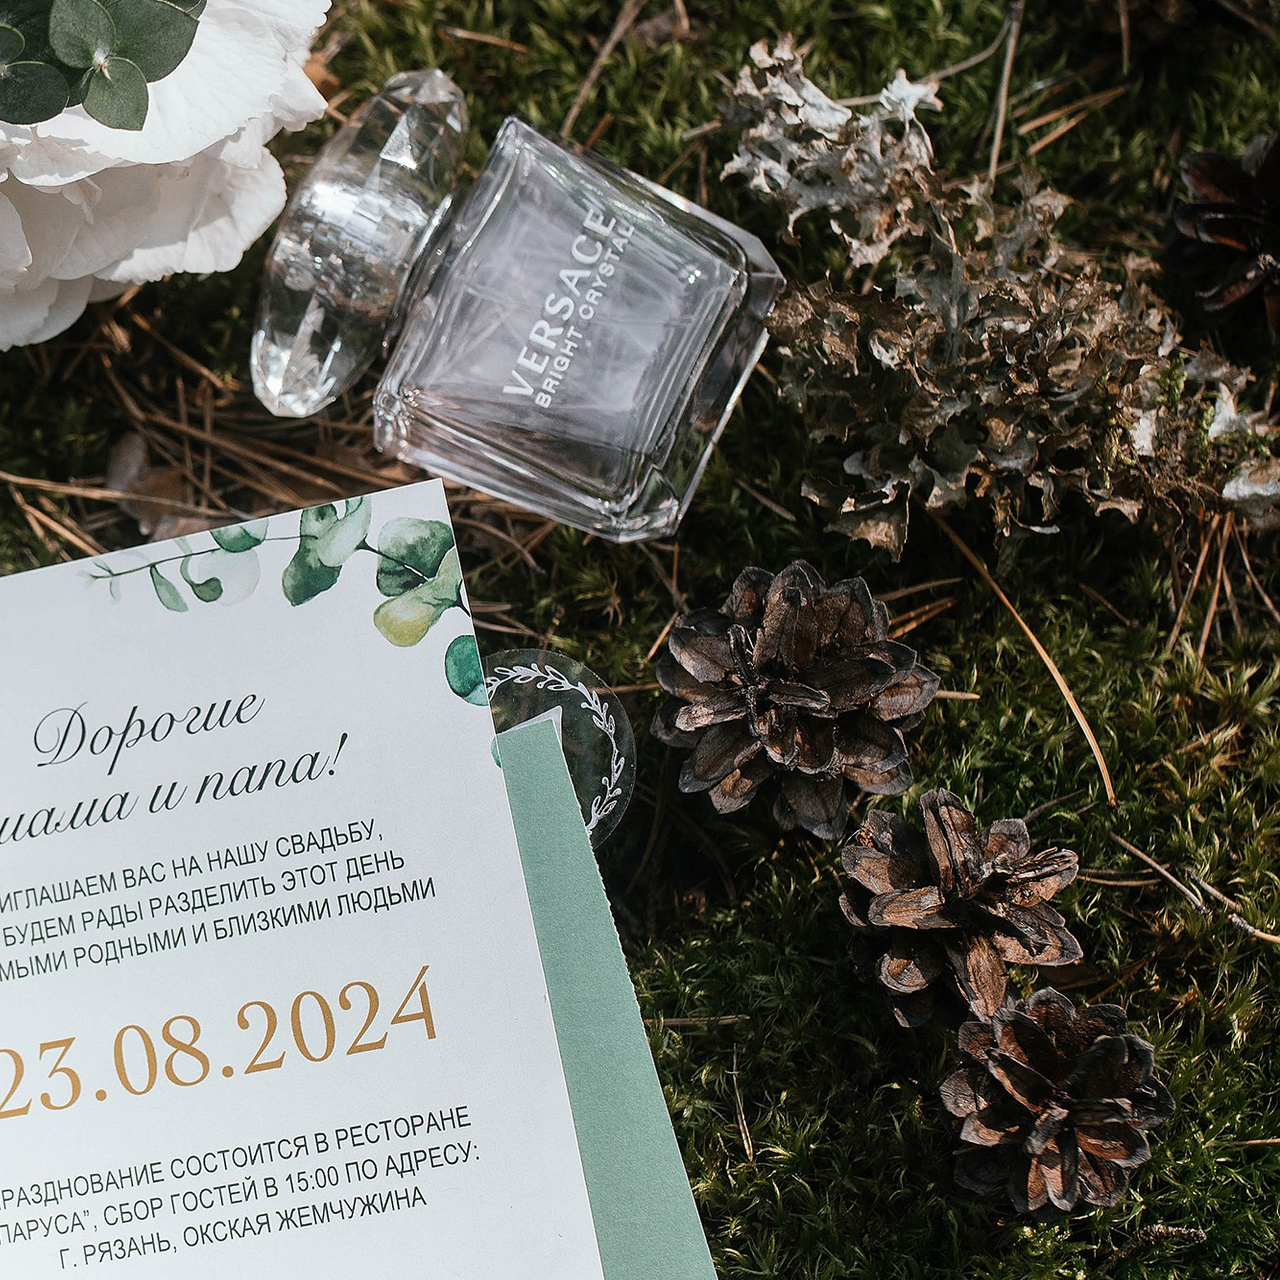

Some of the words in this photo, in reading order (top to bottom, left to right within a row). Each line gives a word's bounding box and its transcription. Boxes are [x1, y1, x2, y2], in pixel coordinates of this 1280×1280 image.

[502, 207, 617, 398] VERSACE
[534, 324, 583, 410] BRIGHT
[578, 224, 636, 321] CRYSTAL
[34, 694, 266, 776] Дорогие
[148, 781, 189, 813] и
[195, 733, 348, 804] папа!
[122, 862, 166, 888] ВАС
[172, 856, 203, 879] НА
[207, 840, 269, 873] НАШУ
[275, 819, 383, 857] СВАДЬБУ,
[3, 915, 75, 946] БУДЕМ
[81, 901, 143, 931] РАДЫ
[149, 875, 276, 918] РАЗДЕЛИТЬ
[280, 861, 337, 891] ЭТОТ
[345, 849, 405, 883] ДЕНЬ
[73, 927, 186, 967] РОДНЫМИ
[192, 923, 207, 944] И
[213, 897, 332, 940] БЛИЗКИМИ
[336, 877, 436, 916] ЛЮДЬМИ
[104, 1197, 163, 1226] СБОР
[171, 1176, 258, 1214] ГОСТЕЙ
[264, 1177, 278, 1198] В
[286, 1166, 339, 1193] 15:00
[345, 1159, 377, 1183] ПО
[386, 1141, 479, 1178] АДРЕСУ:
[171, 1135, 309, 1179] СОСТОИТСЯ
[314, 1132, 329, 1153] В
[334, 1105, 472, 1149] РЕСТОРАНЕ
[60, 1248, 78, 1269] Г.
[83, 1232, 176, 1265] РЯЗАНЬ,
[184, 1213, 271, 1247] ОКСКАЯ
[275, 1186, 427, 1231] ЖЕМЧУЖИНА
